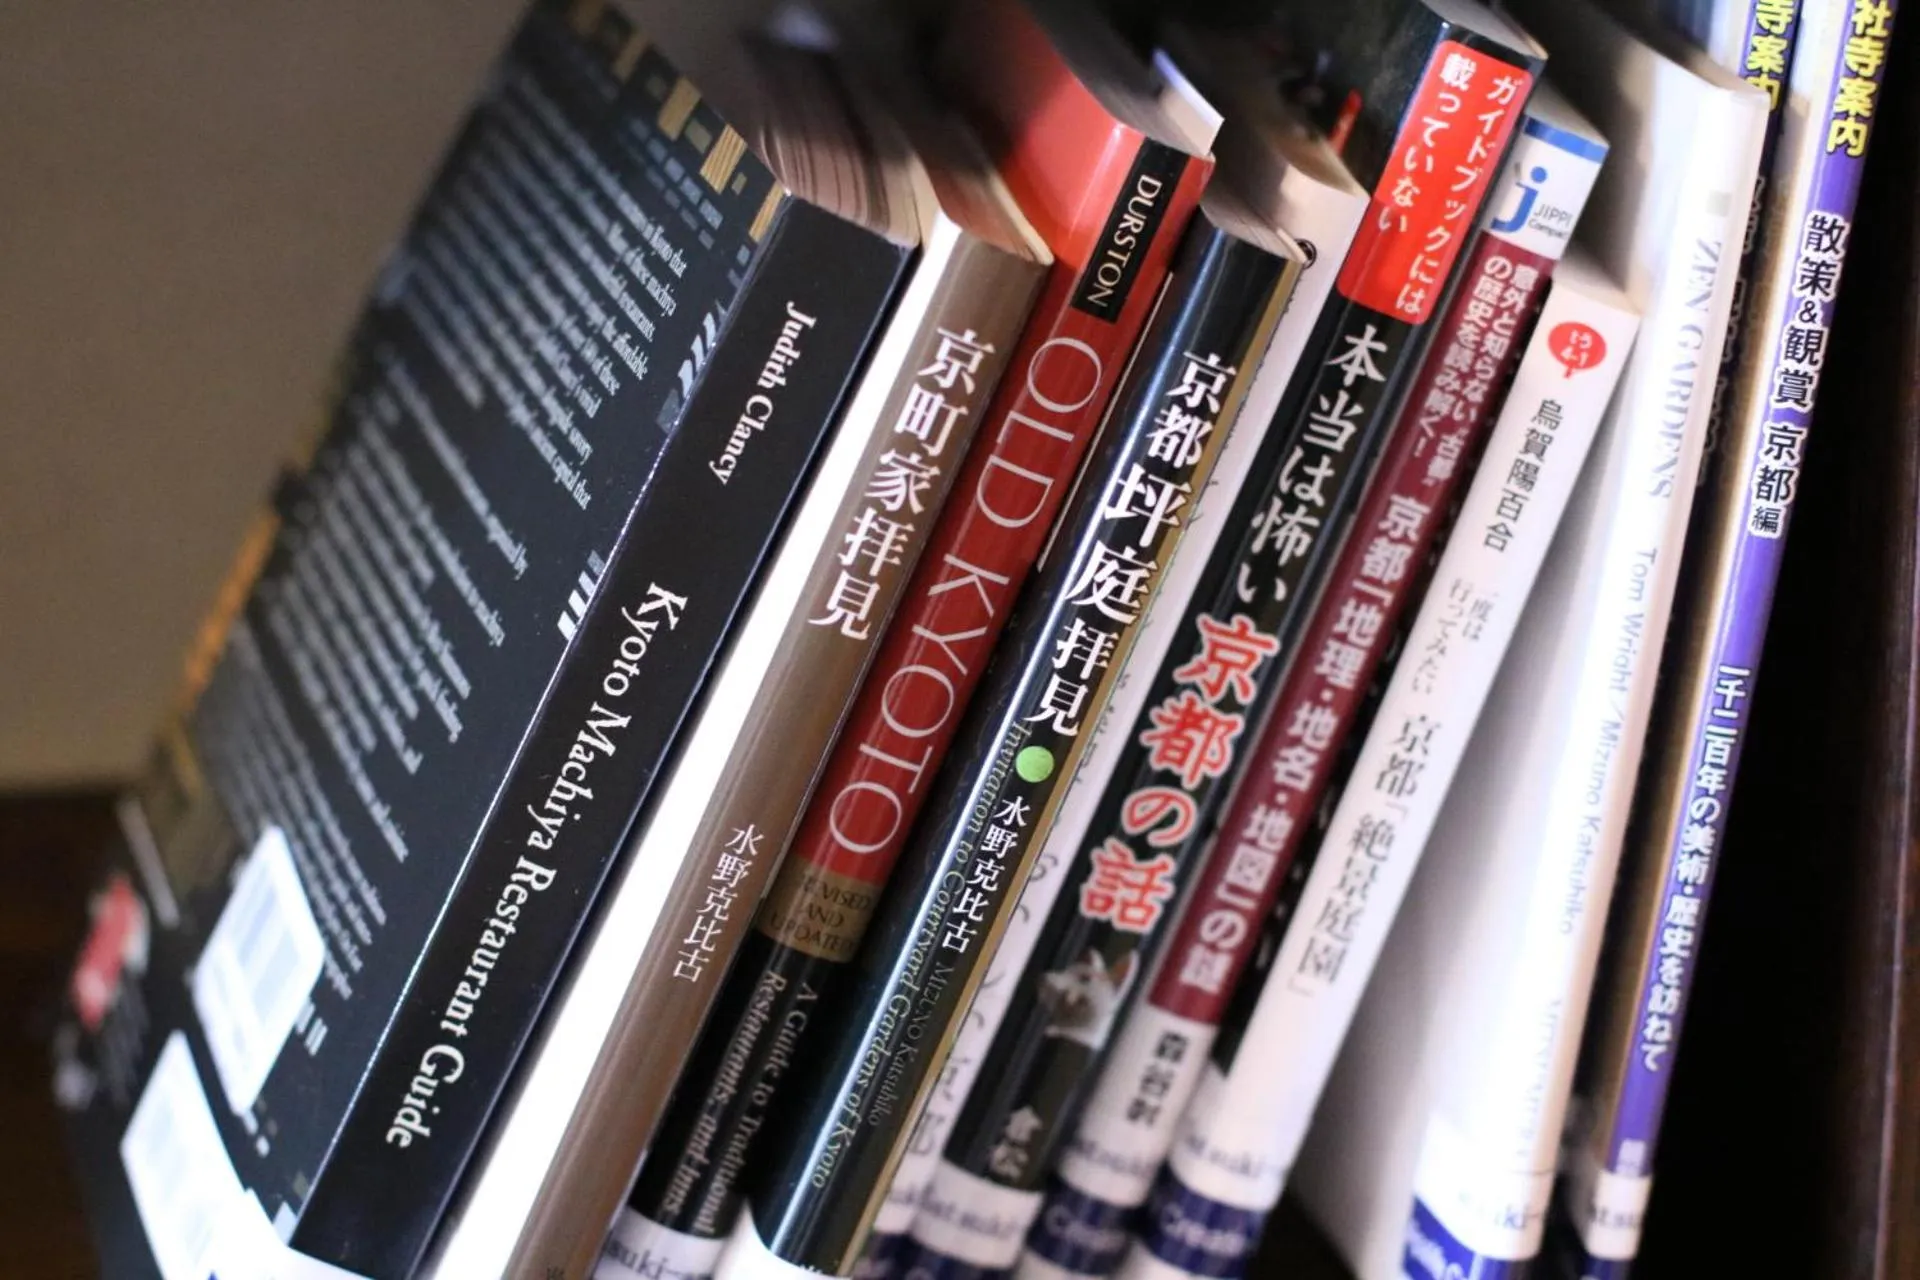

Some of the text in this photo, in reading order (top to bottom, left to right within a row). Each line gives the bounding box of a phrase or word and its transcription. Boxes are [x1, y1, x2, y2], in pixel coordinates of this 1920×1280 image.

[1377, 52, 1477, 233] 載っていない
[1826, 0, 1894, 157] 社寺案内
[1087, 173, 1164, 308] DURSTON
[1395, 75, 1523, 314] ガイドブックには
[708, 300, 817, 487] Judith Clancy
[1644, 237, 1723, 500] ZEN GARDENS
[808, 327, 997, 641] 京町家拝見
[1022, 348, 1238, 738] 京都坪庭拝見
[828, 336, 1103, 855] OLD KYOTO
[1626, 546, 1658, 603] Tom
[1610, 604, 1650, 693] Wright
[387, 580, 690, 1149] Kyoto Machiya Restaurant Guide
[672, 824, 766, 983] 水野克比古
[941, 795, 1031, 954] 水野克比古
[955, 839, 974, 864] to
[796, 982, 818, 1001] A
[900, 870, 966, 992] Courtyard
[752, 1081, 776, 1106] to
[764, 1009, 808, 1078] Guide
[843, 1091, 863, 1124] of
[856, 993, 912, 1089] Gardens
[811, 1120, 857, 1189] Kyoto
